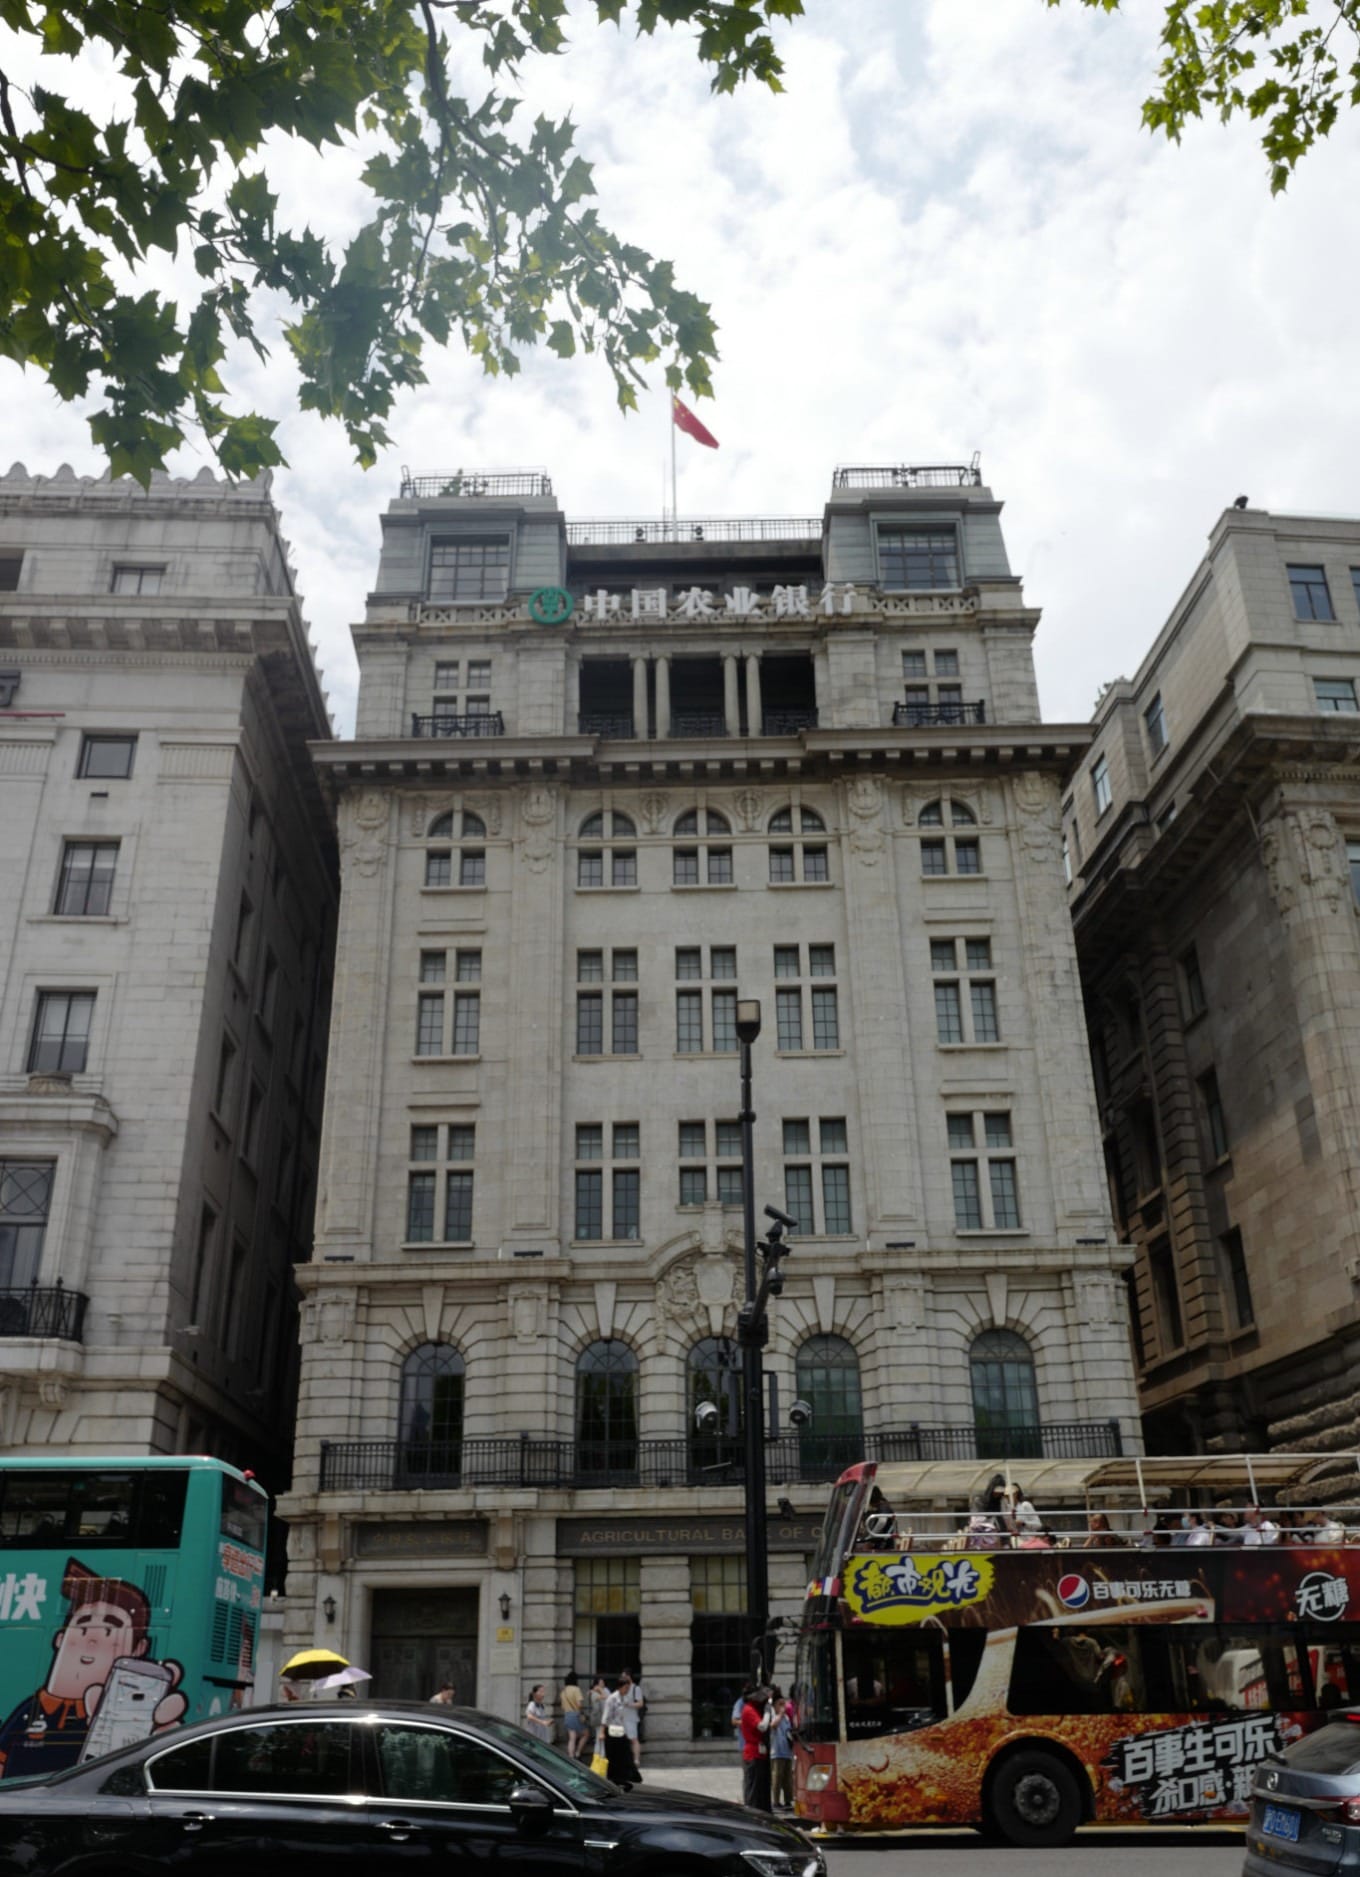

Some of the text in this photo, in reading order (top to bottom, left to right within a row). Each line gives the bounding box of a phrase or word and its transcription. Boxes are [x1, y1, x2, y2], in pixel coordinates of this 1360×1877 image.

[584, 583, 857, 619] 中国农业银行
[580, 1527, 715, 1543] AGRICULTURAL
[779, 1527, 804, 1540] OF
[0, 1573, 47, 1621] 快
[857, 1554, 981, 1603] 都市观光
[1093, 1580, 1191, 1599] 百事可乐无糖
[1295, 1577, 1350, 1616] 无糖
[1123, 1715, 1279, 1786] 百事生可乐
